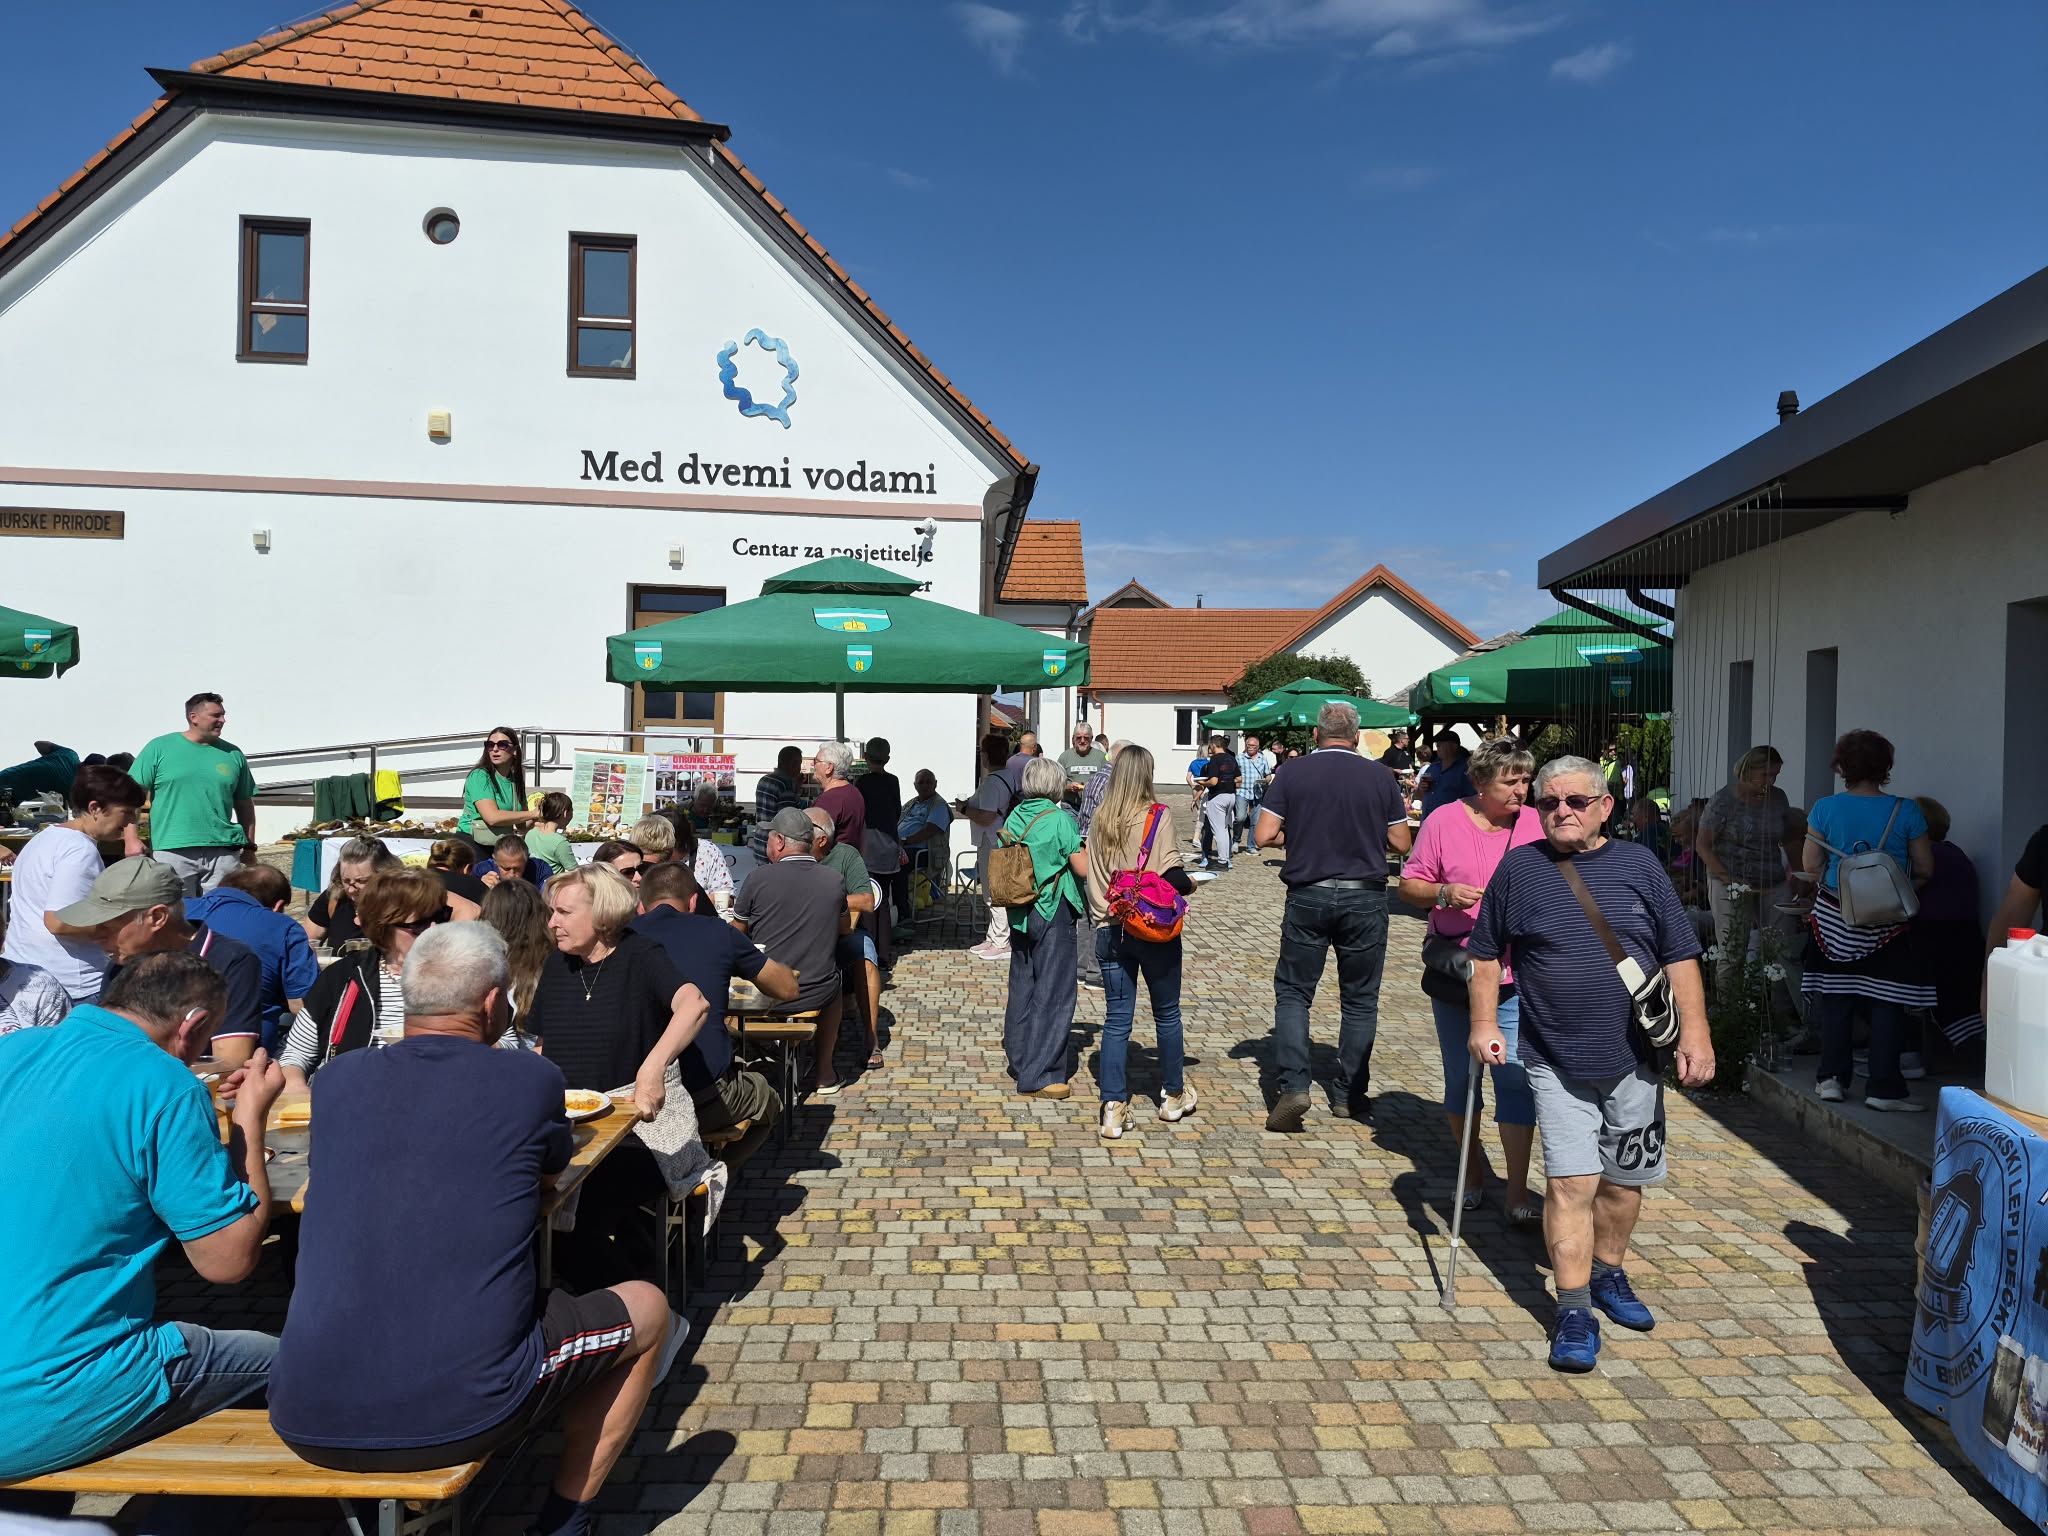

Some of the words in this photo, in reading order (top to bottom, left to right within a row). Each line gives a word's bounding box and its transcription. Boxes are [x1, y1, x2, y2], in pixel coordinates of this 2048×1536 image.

[580, 450, 664, 483] Med
[677, 452, 792, 489] dvemi
[802, 460, 938, 495] vodami
[53, 514, 112, 531] PRIRODE
[732, 537, 799, 558] Centar
[803, 546, 824, 558] za
[2005, 1178, 2022, 1238] LEPI
